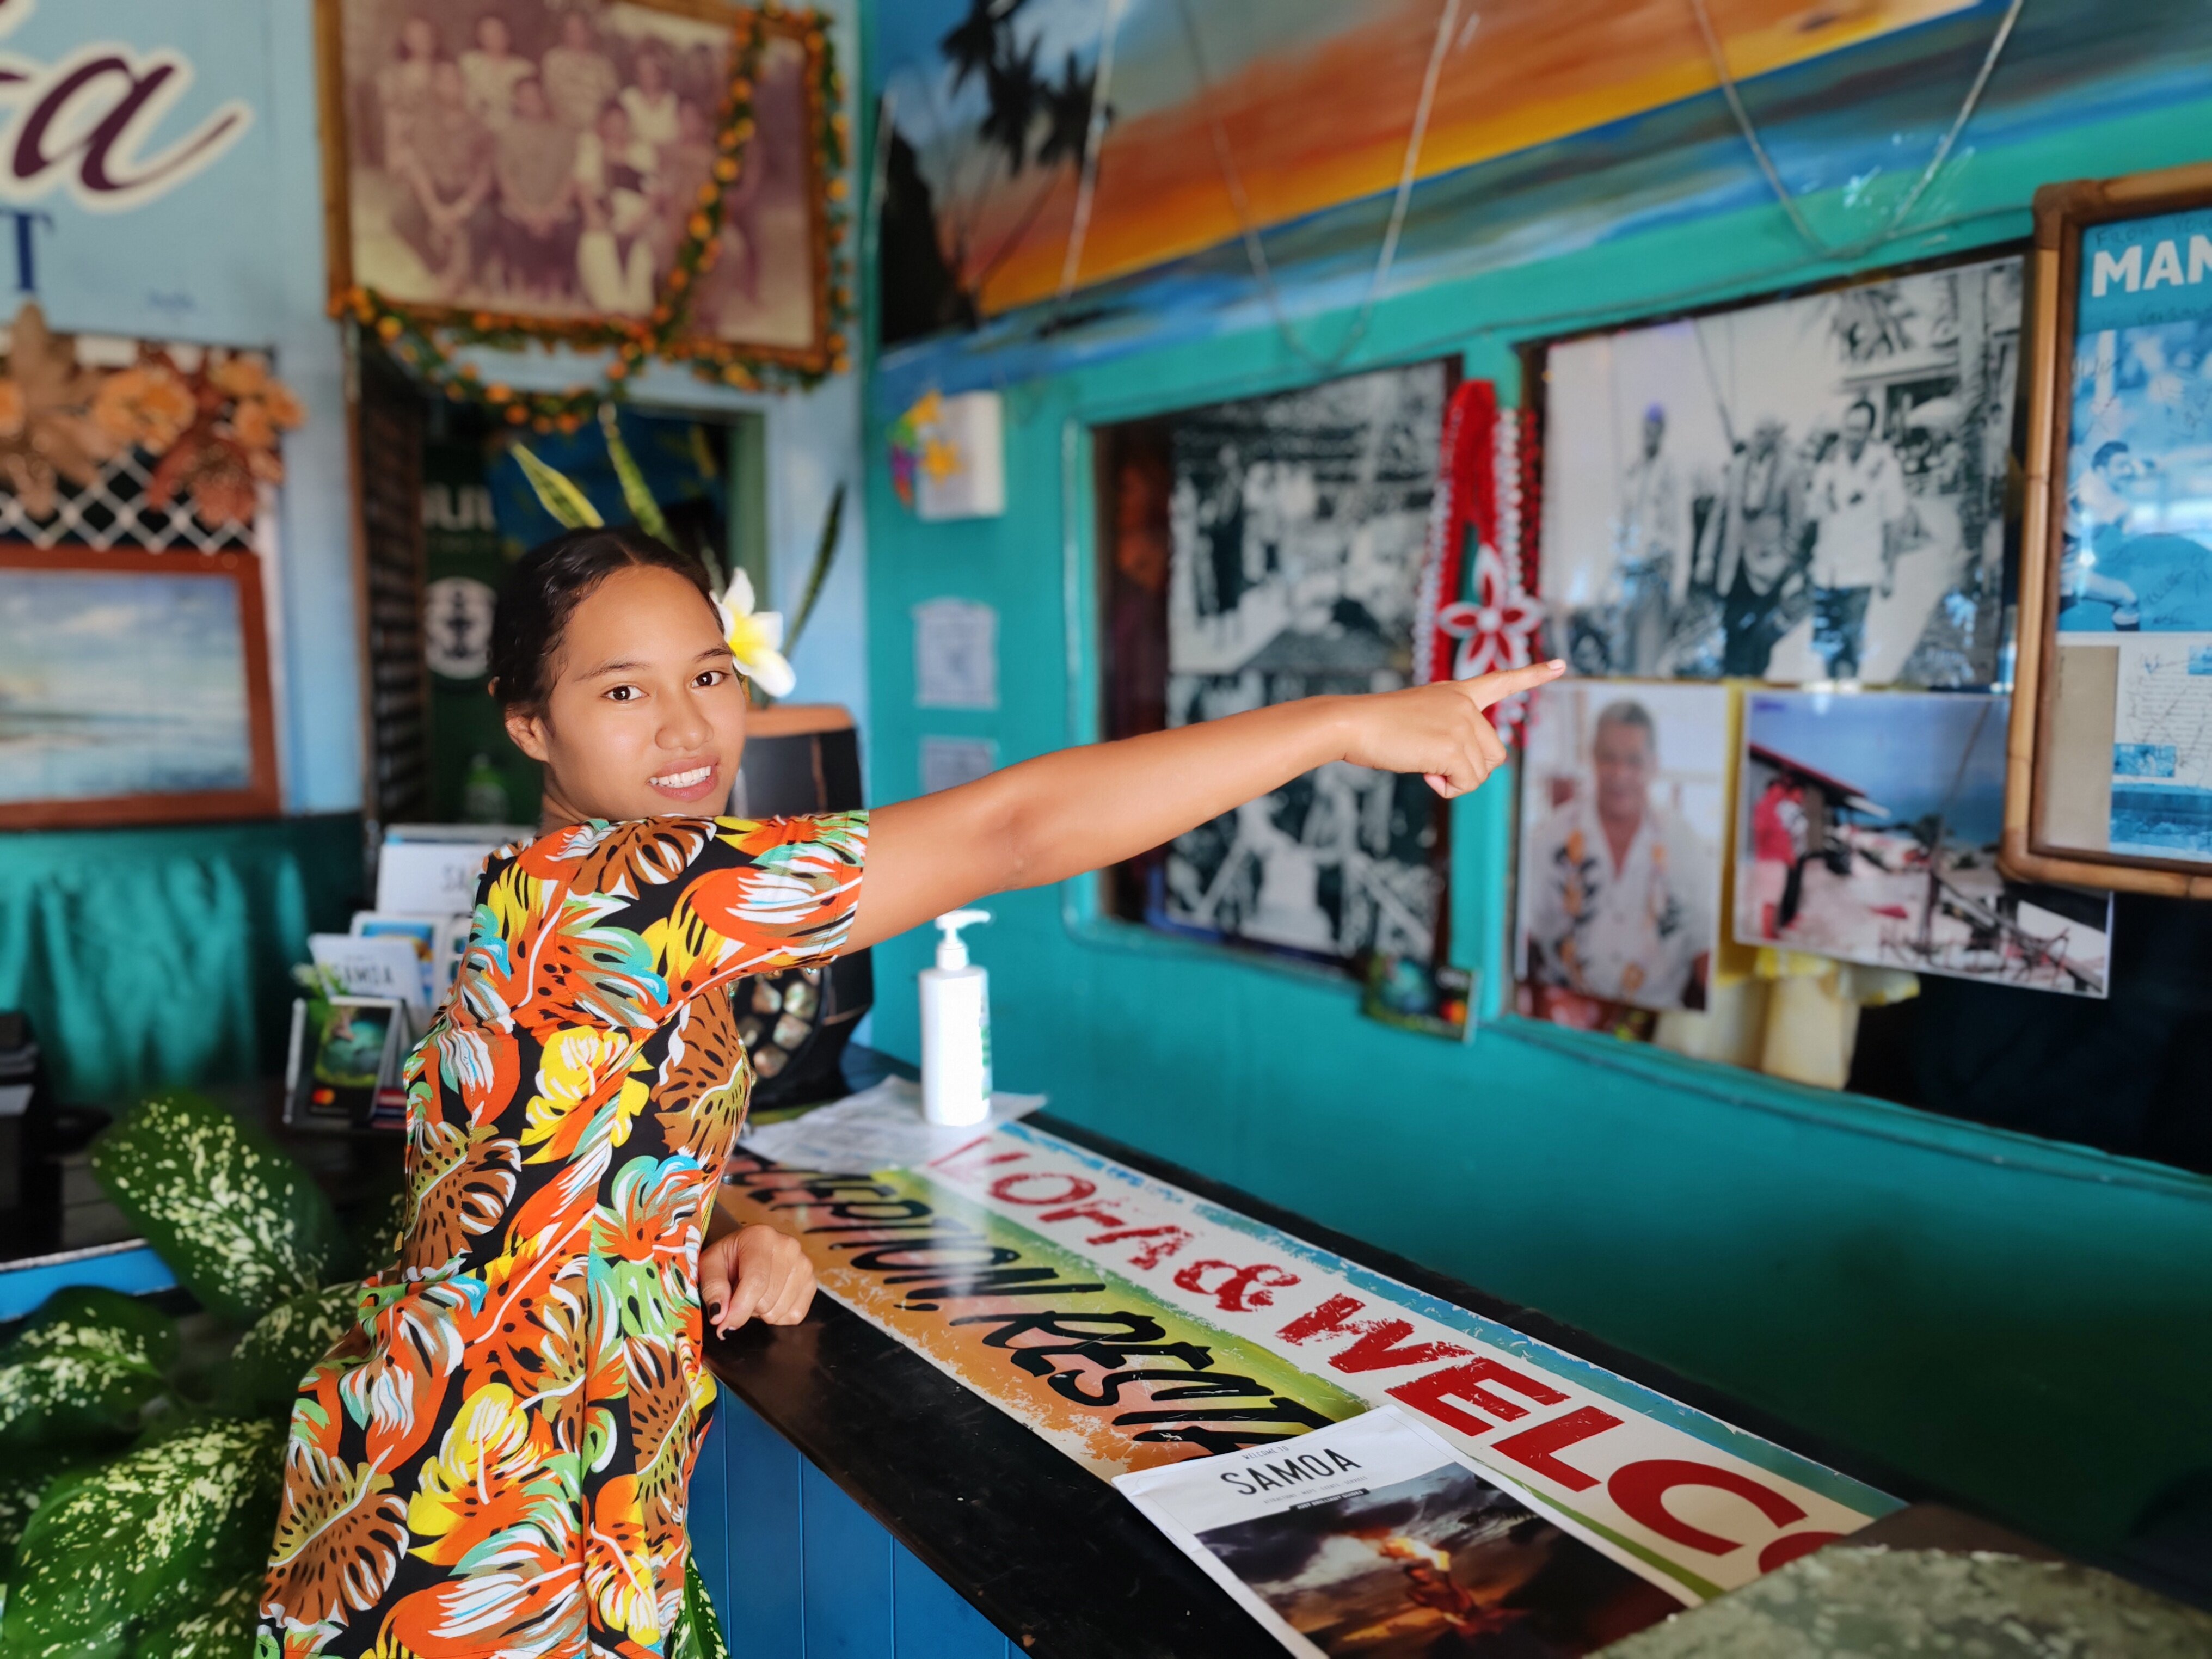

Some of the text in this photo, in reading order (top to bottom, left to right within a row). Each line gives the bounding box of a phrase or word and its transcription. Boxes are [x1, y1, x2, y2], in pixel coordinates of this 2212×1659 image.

[1242, 1448, 1278, 1459] WELCOME
[1220, 1448, 1362, 1495] SAMOA
[1263, 1493, 1298, 1504] ATTRACTIONS
[1321, 1482, 1341, 1490] EVENTS
[1343, 1476, 1368, 1485] SERVICES
[1311, 1496, 1341, 1506] BRILLIANT
[1341, 1489, 1364, 1498] GUIDES
